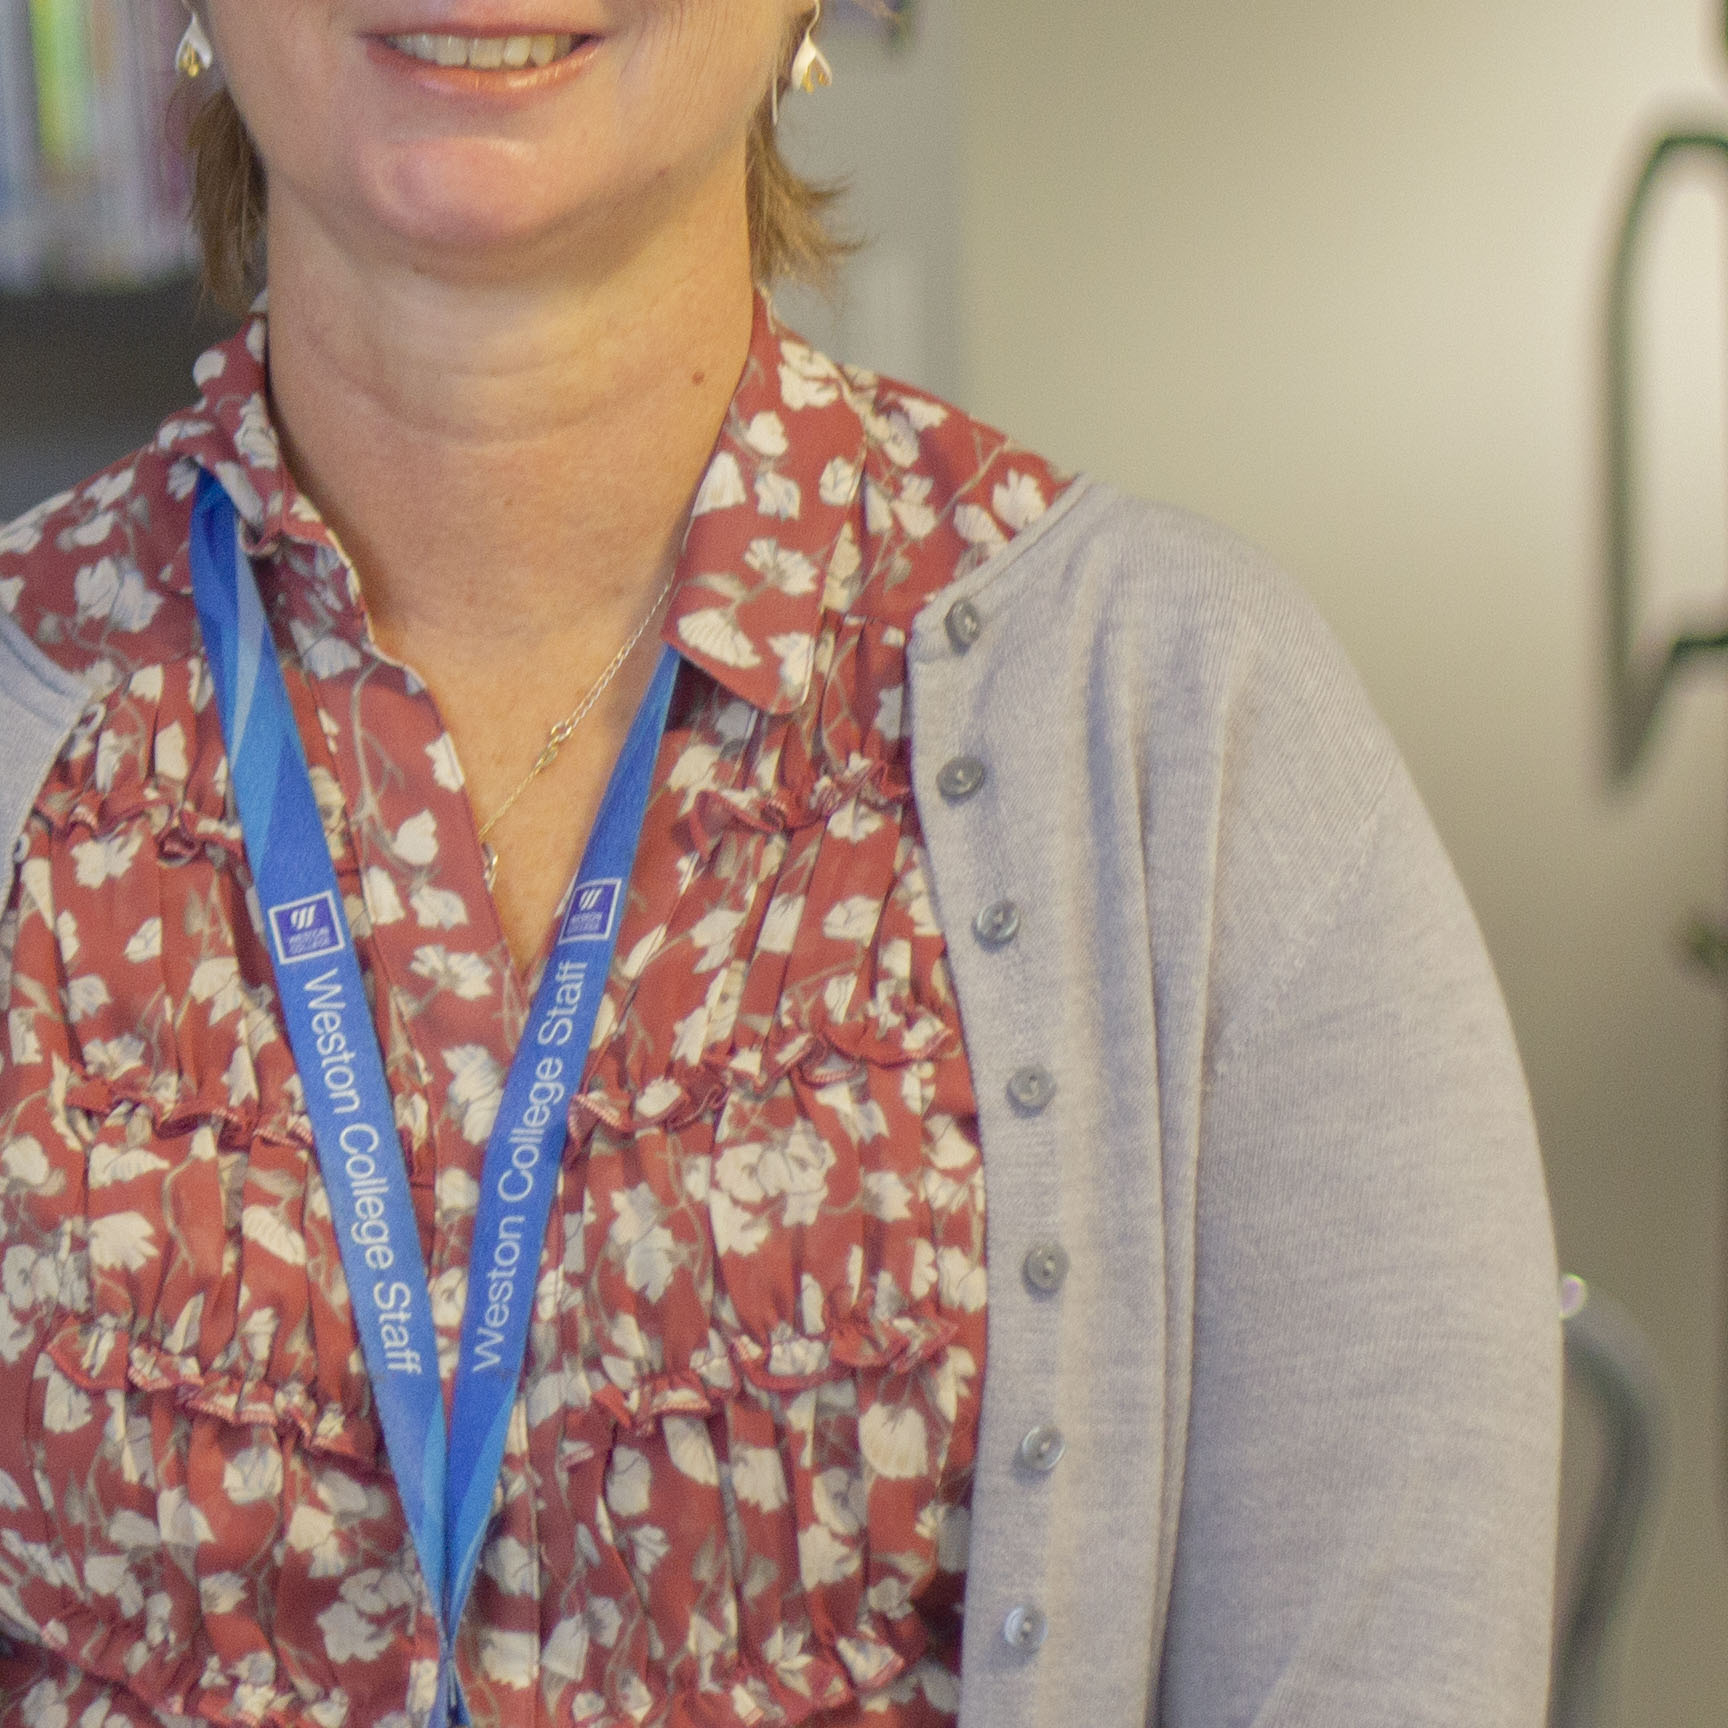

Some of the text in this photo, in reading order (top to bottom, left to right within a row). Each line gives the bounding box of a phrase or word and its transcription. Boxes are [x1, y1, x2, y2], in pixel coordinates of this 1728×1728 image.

[537, 960, 588, 1046] Staff
[303, 968, 361, 1114] Weston
[338, 1122, 395, 1270] College
[372, 1281, 422, 1375] Staff
[497, 1058, 565, 1202] College
[473, 1215, 525, 1372] Weston
